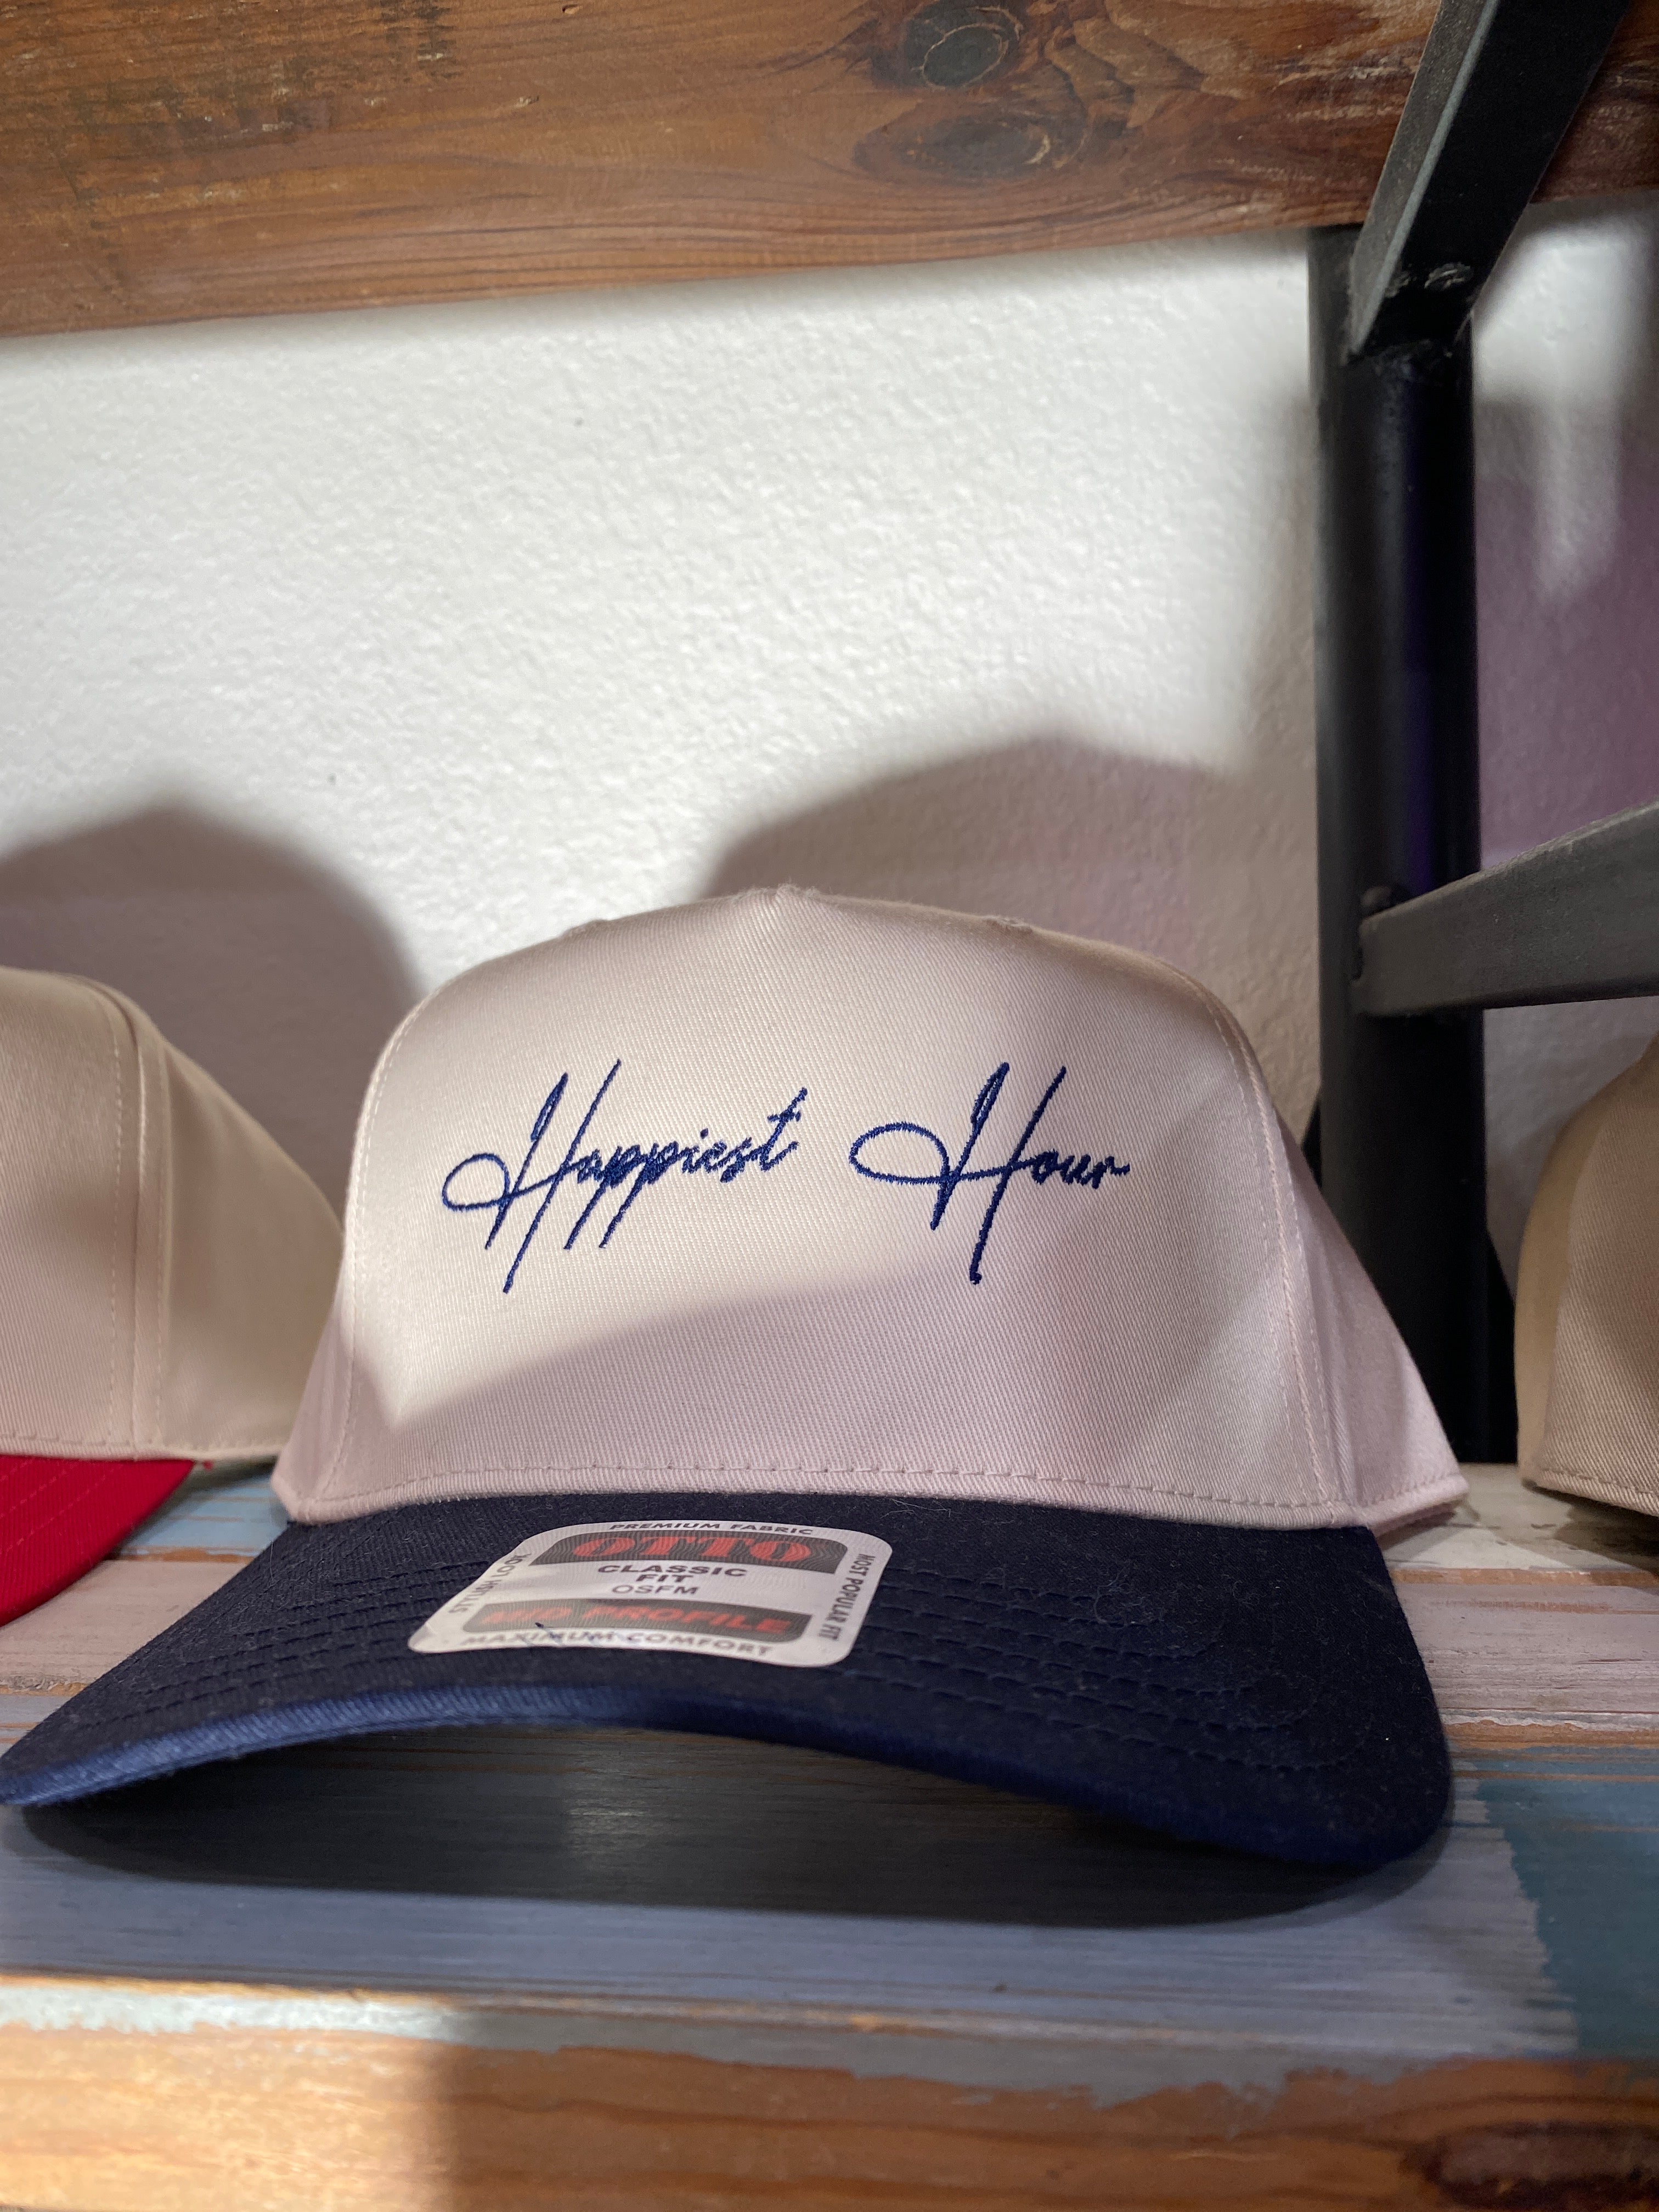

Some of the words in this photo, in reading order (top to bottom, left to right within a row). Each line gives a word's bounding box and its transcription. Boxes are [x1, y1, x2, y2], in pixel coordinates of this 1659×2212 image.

[441, 1059, 808, 1294] Happiest
[849, 1061, 1131, 1285] Hour
[730, 1523, 814, 1536] FABRIC
[572, 1536, 811, 1562] OTTO
[491, 1553, 532, 1578] LOOK
[597, 1565, 748, 1577] CLASSIC
[849, 1553, 876, 1576] MOST
[611, 1584, 700, 1595] OSFM
[635, 1573, 694, 1583] FIT
[825, 1577, 865, 1623] POPULAR
[581, 1606, 791, 1634] PROFILE
[817, 1623, 842, 1641] FIT
[628, 1632, 773, 1656] COMFORT
